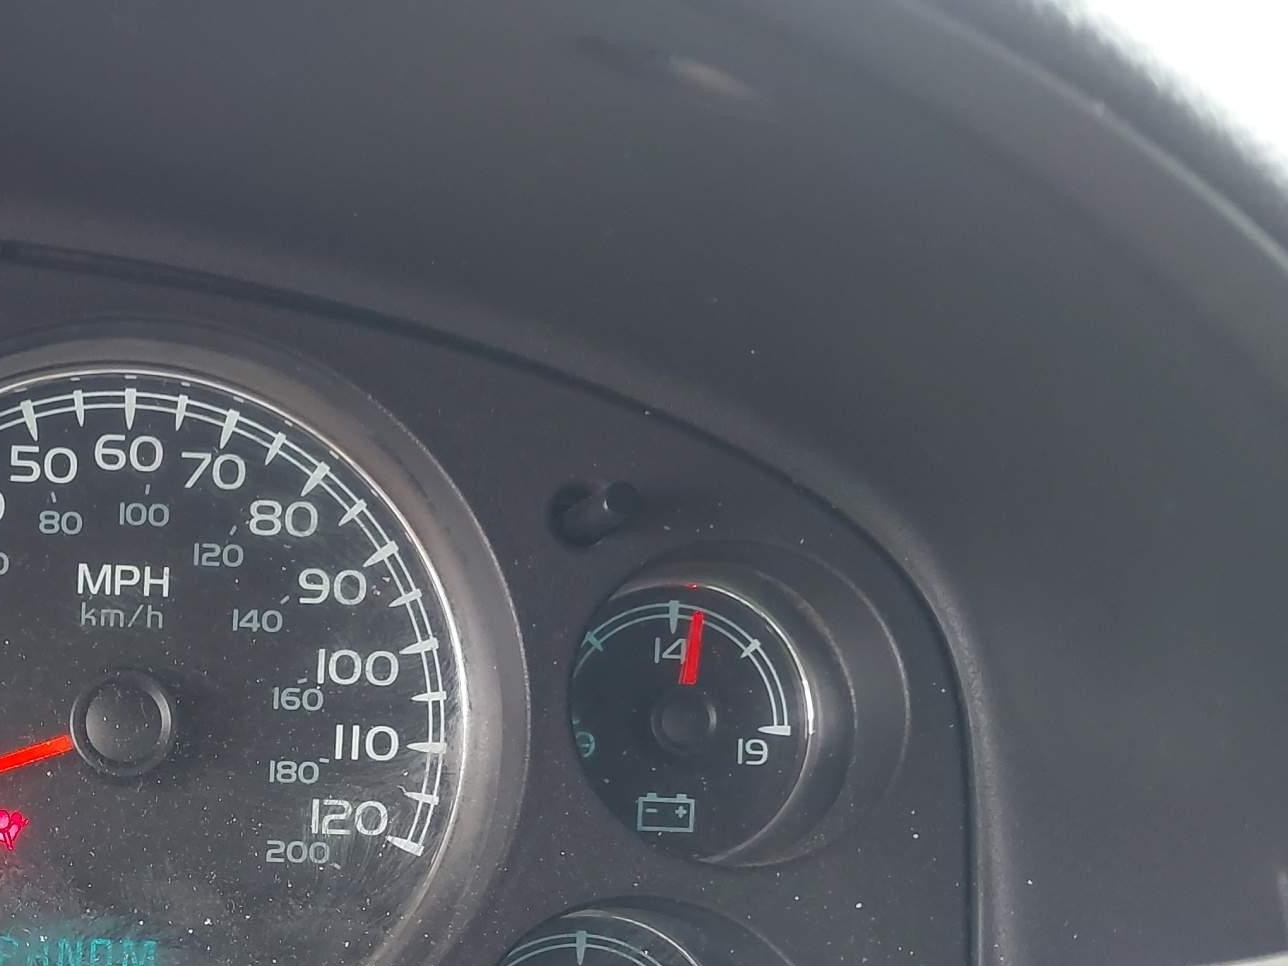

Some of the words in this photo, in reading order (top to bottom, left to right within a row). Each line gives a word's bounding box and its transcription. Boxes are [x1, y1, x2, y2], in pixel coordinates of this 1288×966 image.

[10, 445, 78, 484] 50
[94, 433, 164, 472] 60
[181, 452, 246, 490] 70
[39, 510, 84, 535] 80
[119, 502, 170, 527] 100
[248, 499, 319, 537] 80
[192, 543, 244, 568] 120
[77, 562, 170, 598] MPH
[298, 568, 367, 606] 90
[80, 602, 163, 628] km/h
[232, 608, 283, 633] 140
[654, 637, 688, 664] 14
[317, 648, 400, 686] 100
[272, 687, 324, 711] 160
[334, 724, 400, 761] 110
[737, 738, 769, 766] 19
[269, 760, 320, 785] 180
[311, 799, 388, 836] 120
[266, 840, 330, 864] 200
